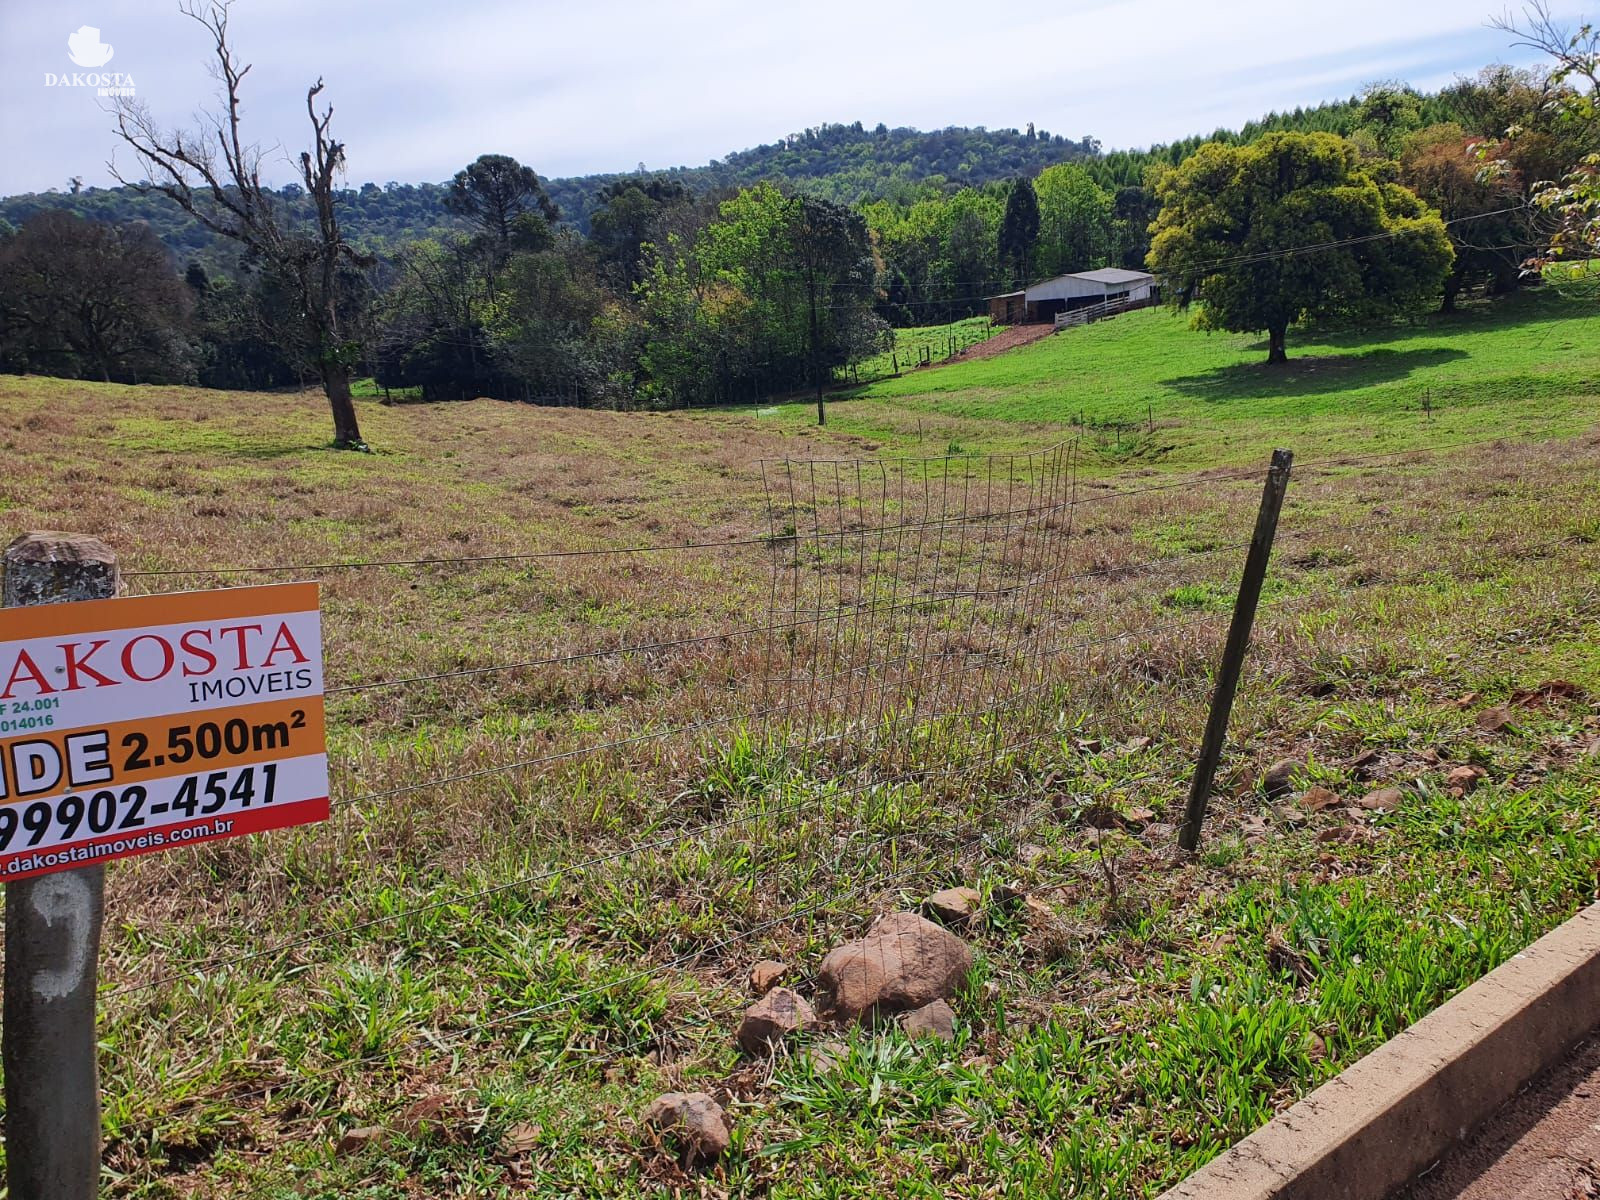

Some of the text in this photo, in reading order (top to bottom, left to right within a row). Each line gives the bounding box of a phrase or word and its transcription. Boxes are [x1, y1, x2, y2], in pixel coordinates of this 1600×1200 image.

[12, 697, 60, 714] 24.001
[189, 669, 312, 703] IMOVEIS
[1, 714, 54, 732] 014016
[121, 709, 306, 771] 2.500m²
[0, 763, 277, 852] 99902-4541
[0, 818, 234, 876] .dakostaimoveis.com.br
